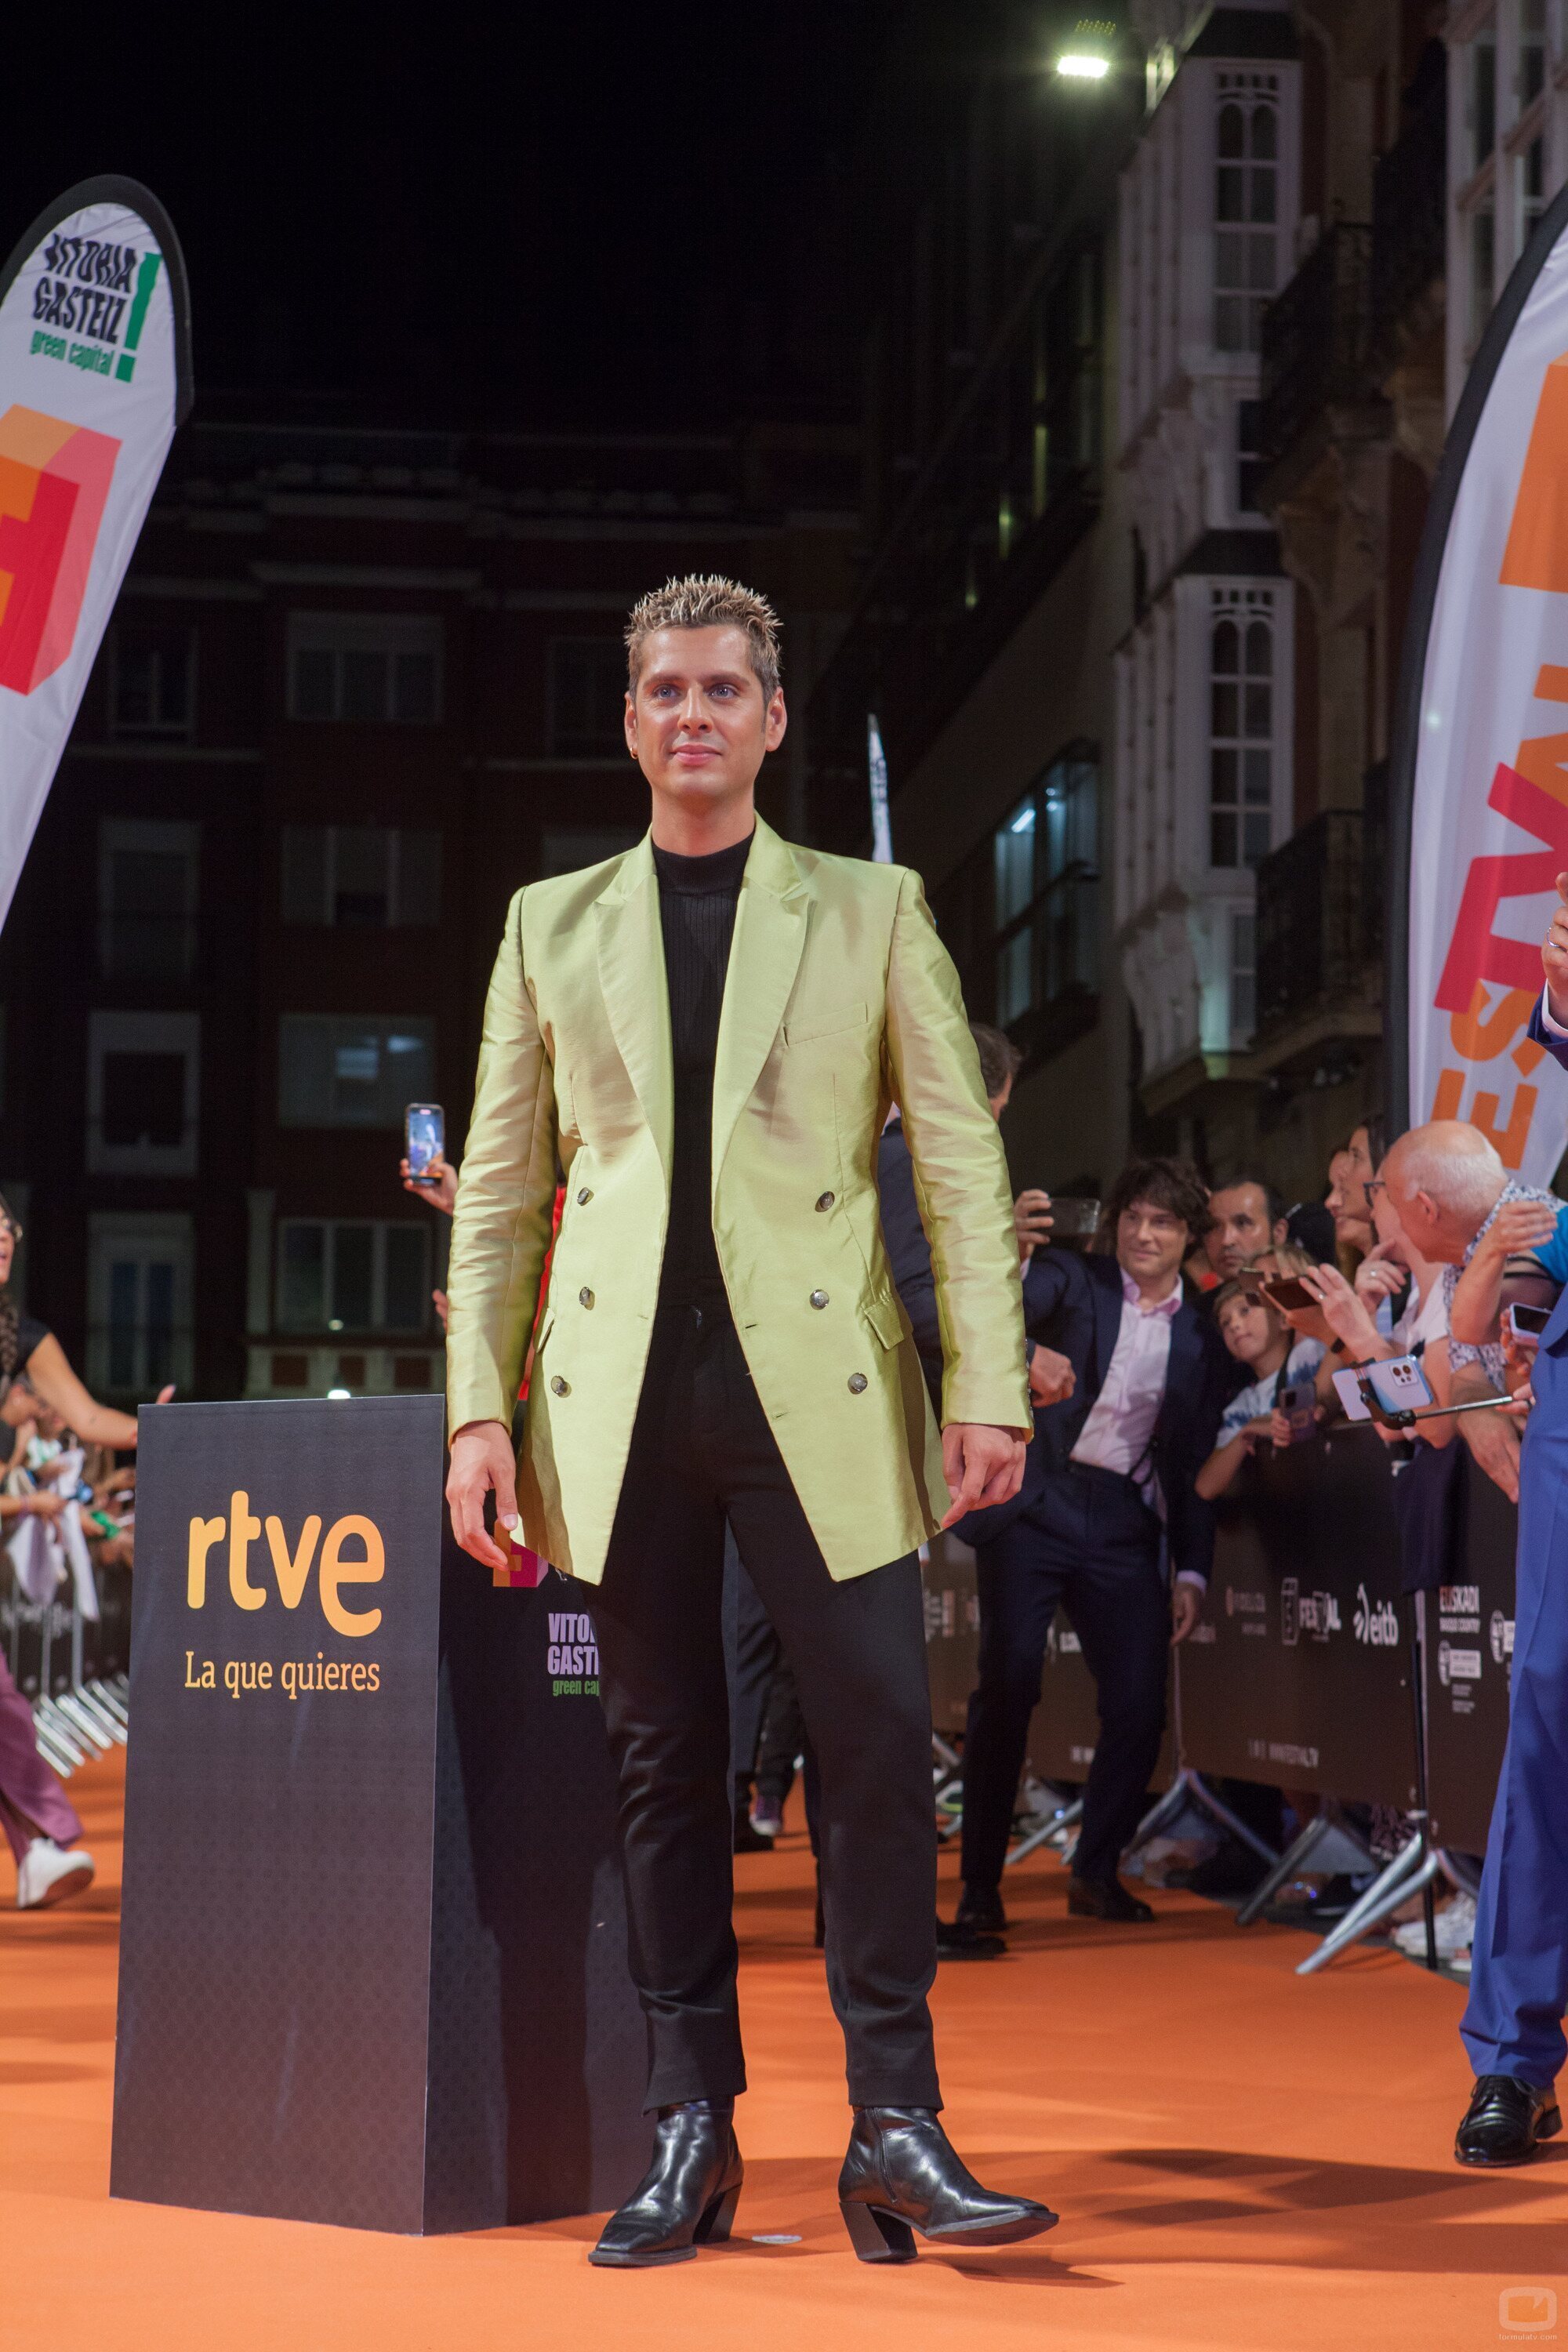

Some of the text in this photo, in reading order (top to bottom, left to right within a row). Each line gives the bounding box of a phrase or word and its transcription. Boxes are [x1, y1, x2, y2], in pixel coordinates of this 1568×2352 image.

[30, 330, 67, 361] green
[187, 1490, 385, 1638] rtve
[1439, 1585, 1480, 1614] EUSKADI
[1370, 1599, 1399, 1646] eitb
[184, 1650, 380, 1700] La que quieres
[553, 1679, 582, 1697] green
